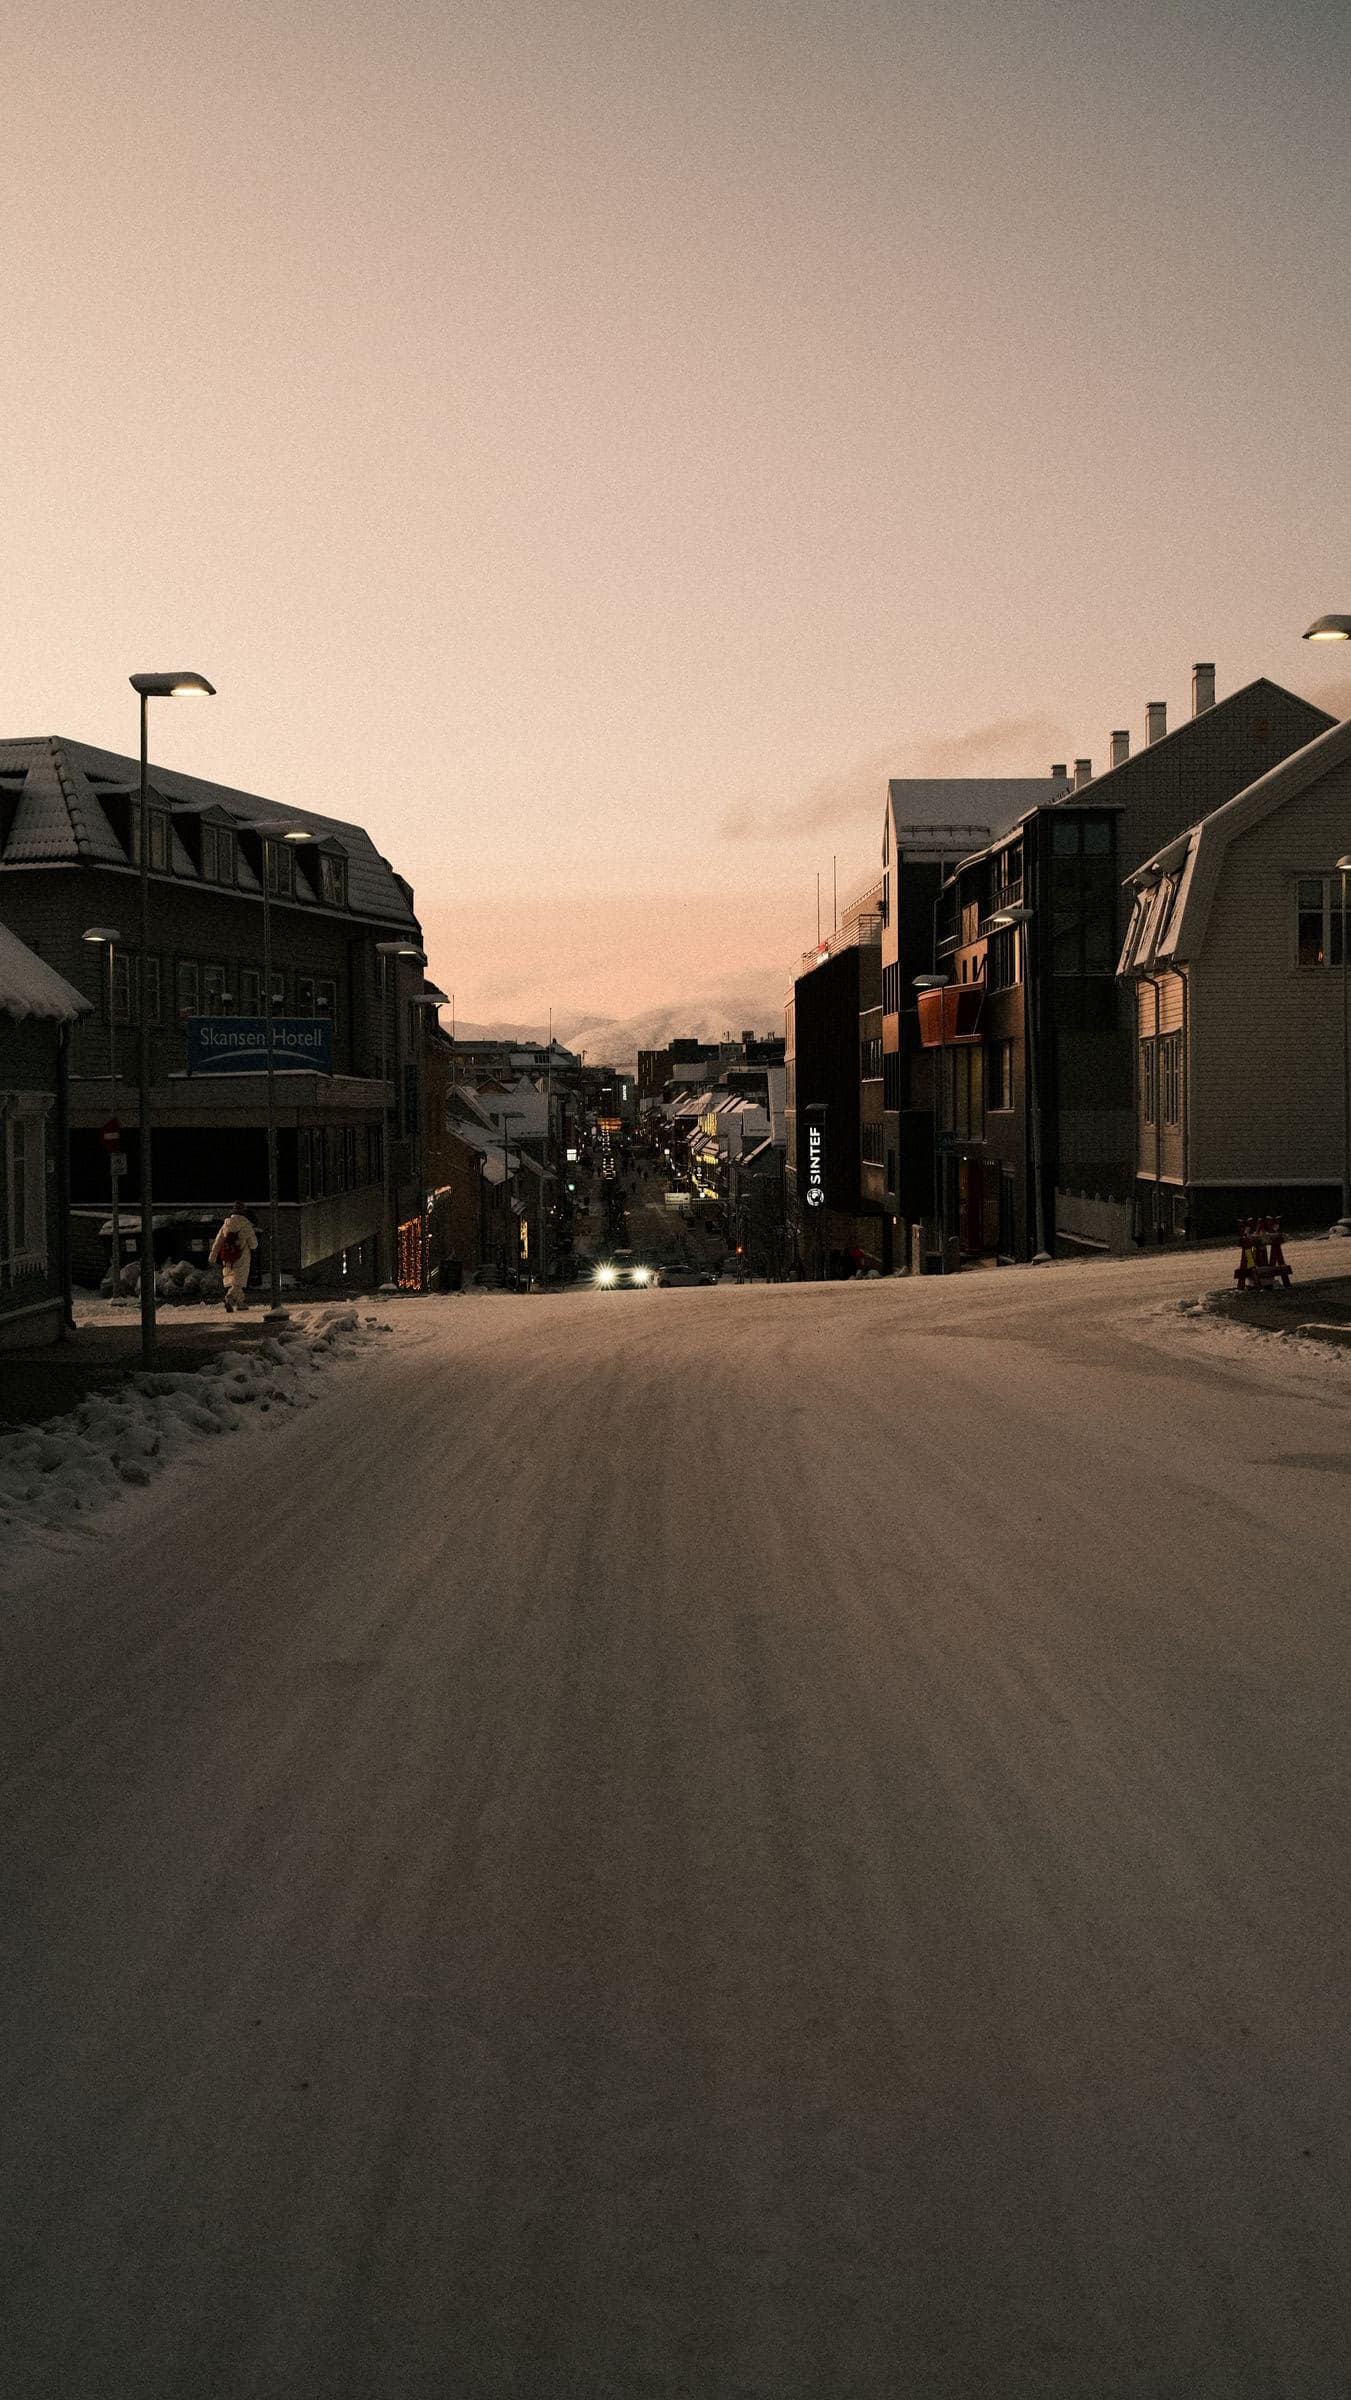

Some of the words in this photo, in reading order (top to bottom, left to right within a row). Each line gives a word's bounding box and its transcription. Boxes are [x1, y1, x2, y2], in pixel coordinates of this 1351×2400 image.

[200, 1028, 265, 1046] Skansen
[273, 1028, 322, 1047] Hotell
[809, 1127, 821, 1185] SINTEF
